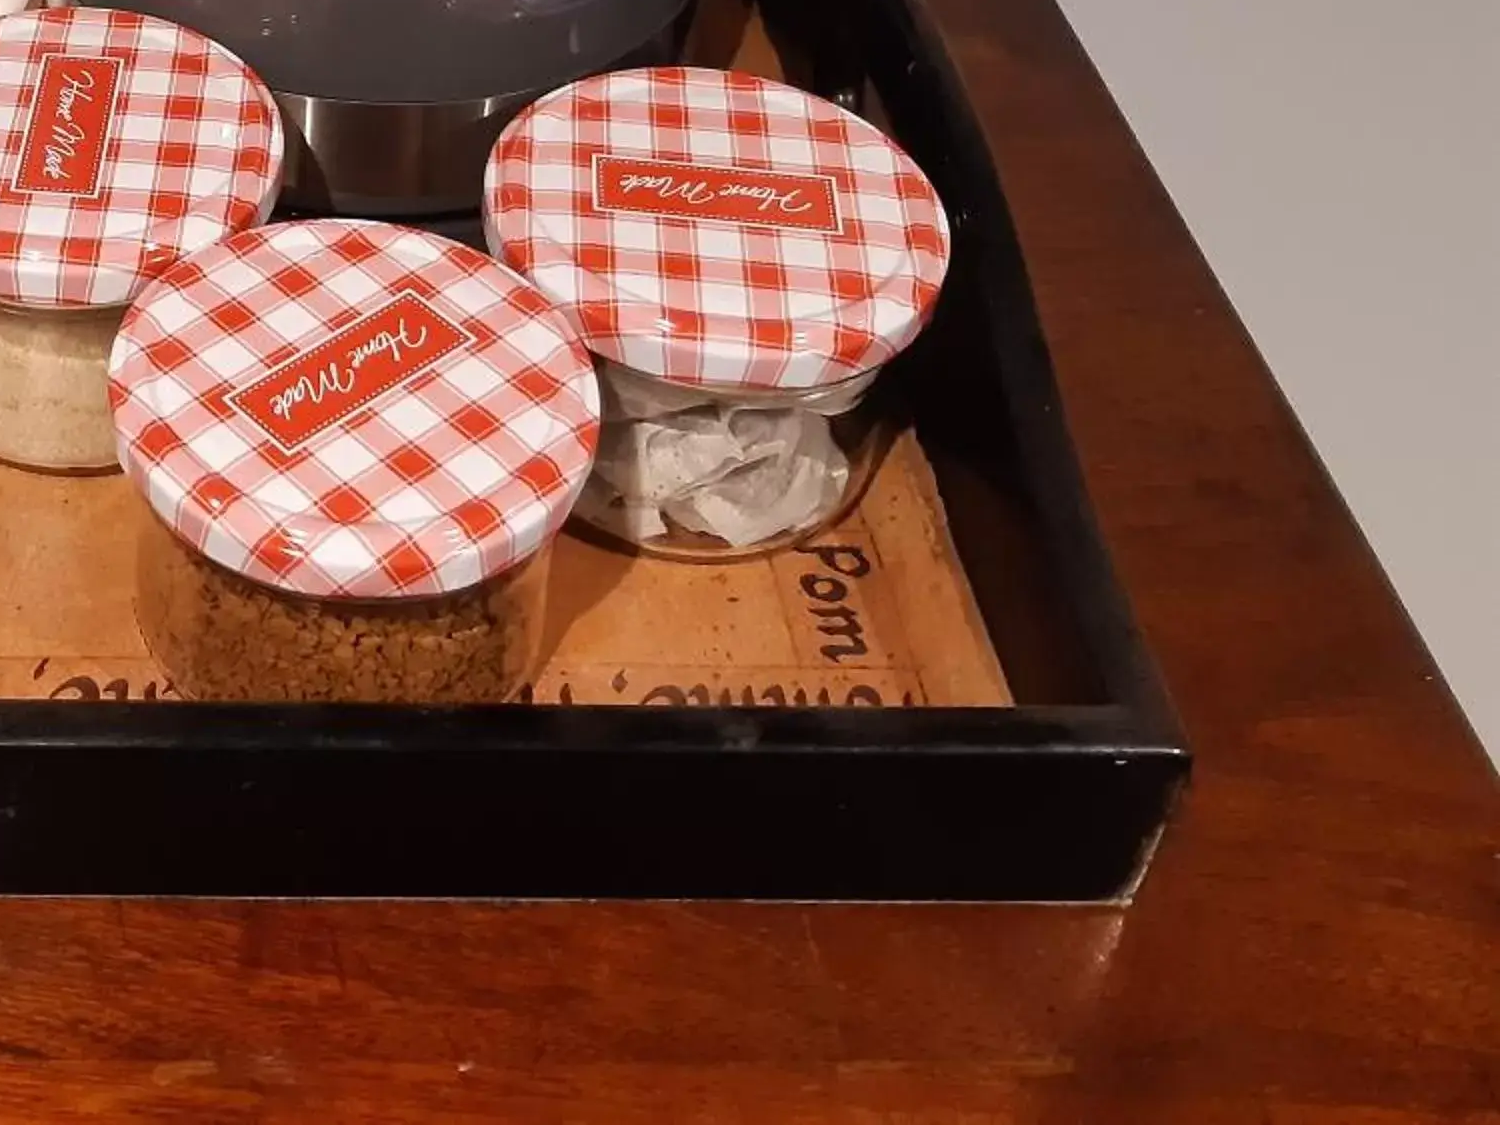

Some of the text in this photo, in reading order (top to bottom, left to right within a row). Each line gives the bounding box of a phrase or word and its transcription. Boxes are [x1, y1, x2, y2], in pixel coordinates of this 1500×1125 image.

[42, 69, 96, 181] Home Made
[618, 172, 813, 213] Home Made
[268, 318, 428, 420] Home Made
